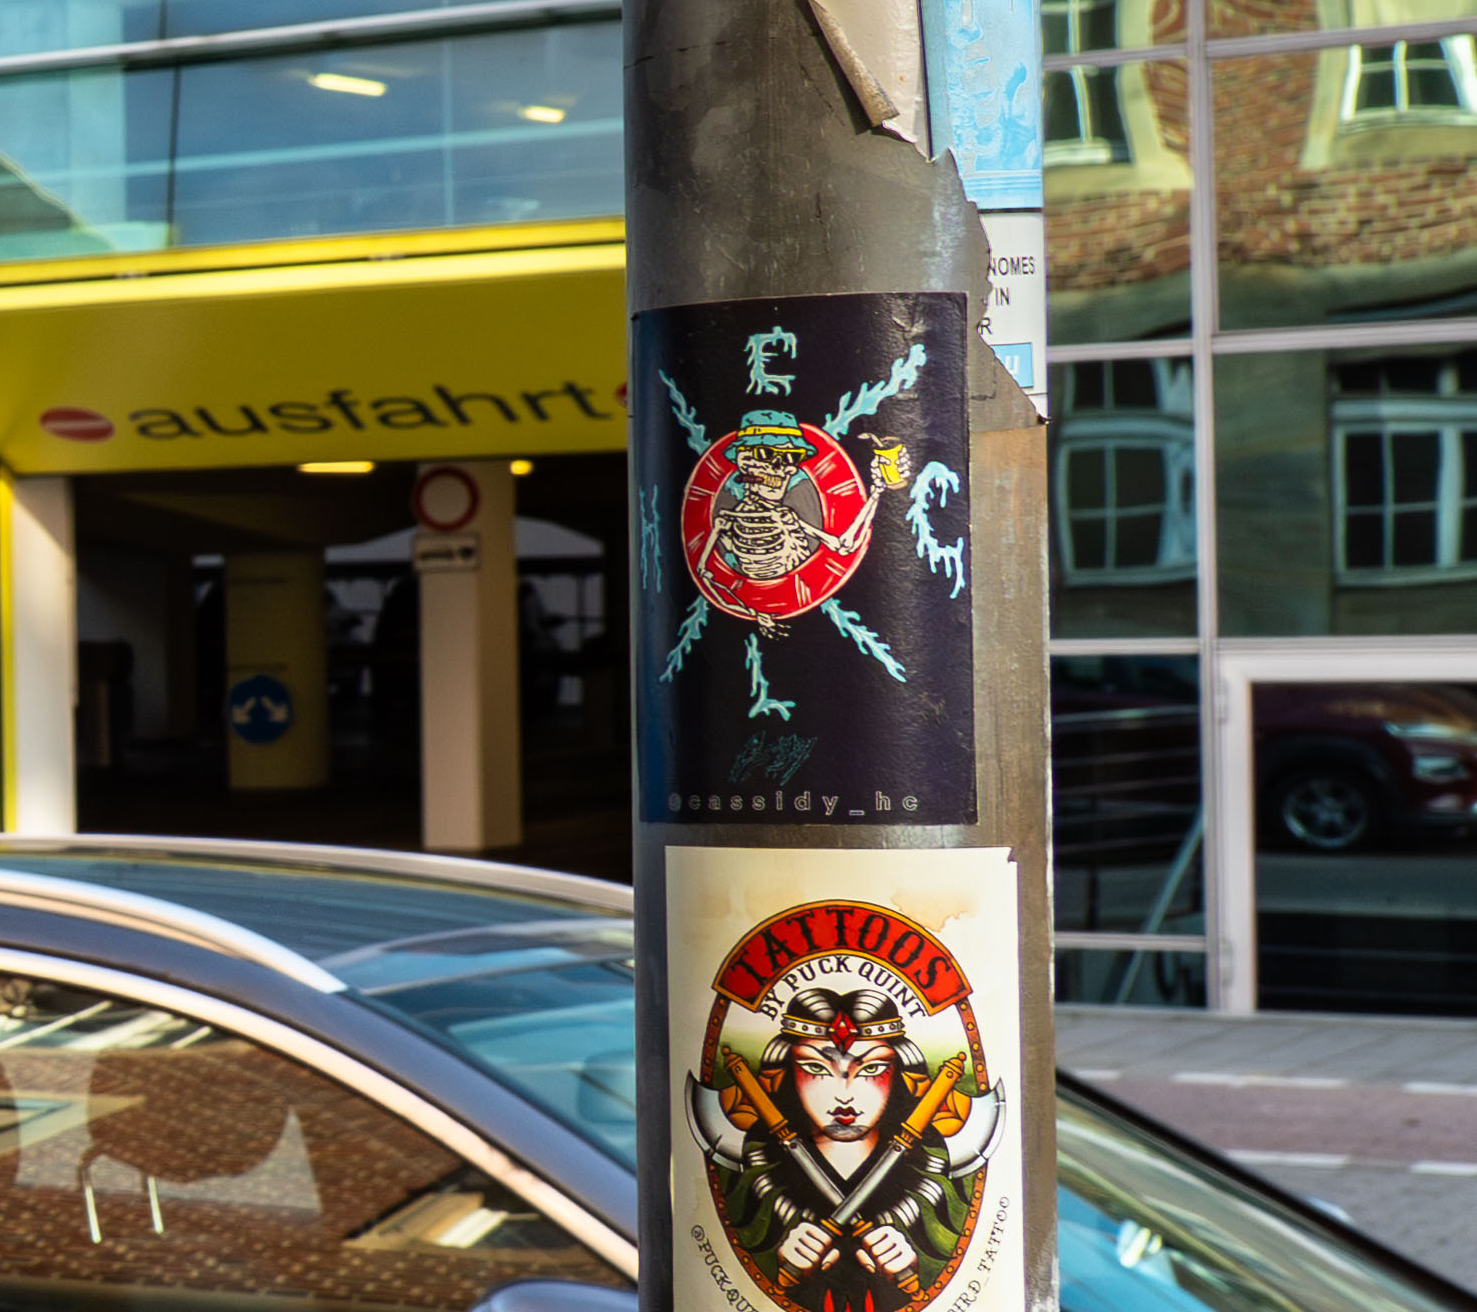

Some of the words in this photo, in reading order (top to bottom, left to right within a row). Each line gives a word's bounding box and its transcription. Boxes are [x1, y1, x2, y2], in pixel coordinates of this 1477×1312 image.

[128, 382, 614, 441] ausfahrt
[729, 907, 952, 991] TATTOOS
[759, 987, 785, 1022] BY
[782, 955, 852, 992] PUCK
[857, 960, 927, 1019] QUINT
